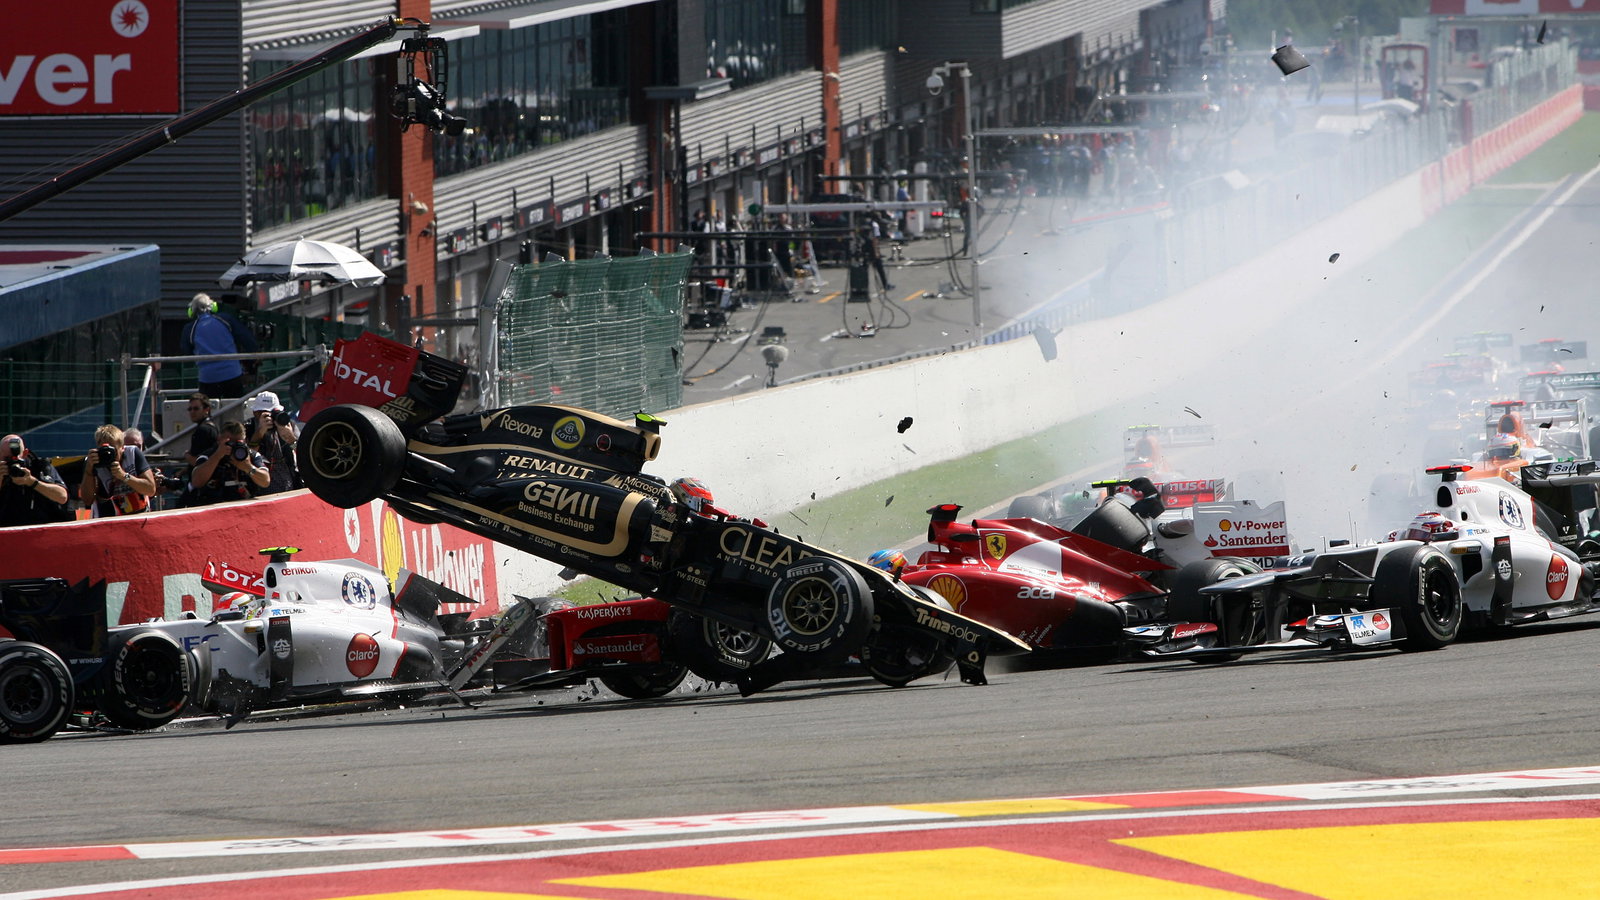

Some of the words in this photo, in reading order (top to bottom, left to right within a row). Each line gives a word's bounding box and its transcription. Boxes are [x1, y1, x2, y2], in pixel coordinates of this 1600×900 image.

[333, 356, 397, 398] TOTAL
[500, 414, 543, 438] Rexona
[556, 429, 578, 441] LOTUS
[504, 455, 594, 480] RENAULT
[624, 476, 665, 497] Microsoft
[518, 501, 552, 520] Business
[554, 513, 594, 532] Exchange
[1233, 520, 1285, 531] V-Power
[1220, 531, 1286, 547] Santander
[411, 524, 486, 615] V-Power
[716, 553, 778, 578] ANTI-DAND
[786, 562, 824, 578] PIRELLI
[1251, 557, 1275, 568] MD
[687, 574, 707, 587] STEEL
[1017, 586, 1056, 600] acer
[577, 606, 626, 620] KASPERSKY
[1350, 629, 1377, 639] TELMEX
[348, 647, 375, 661] Claro
[586, 640, 644, 654] Santander
